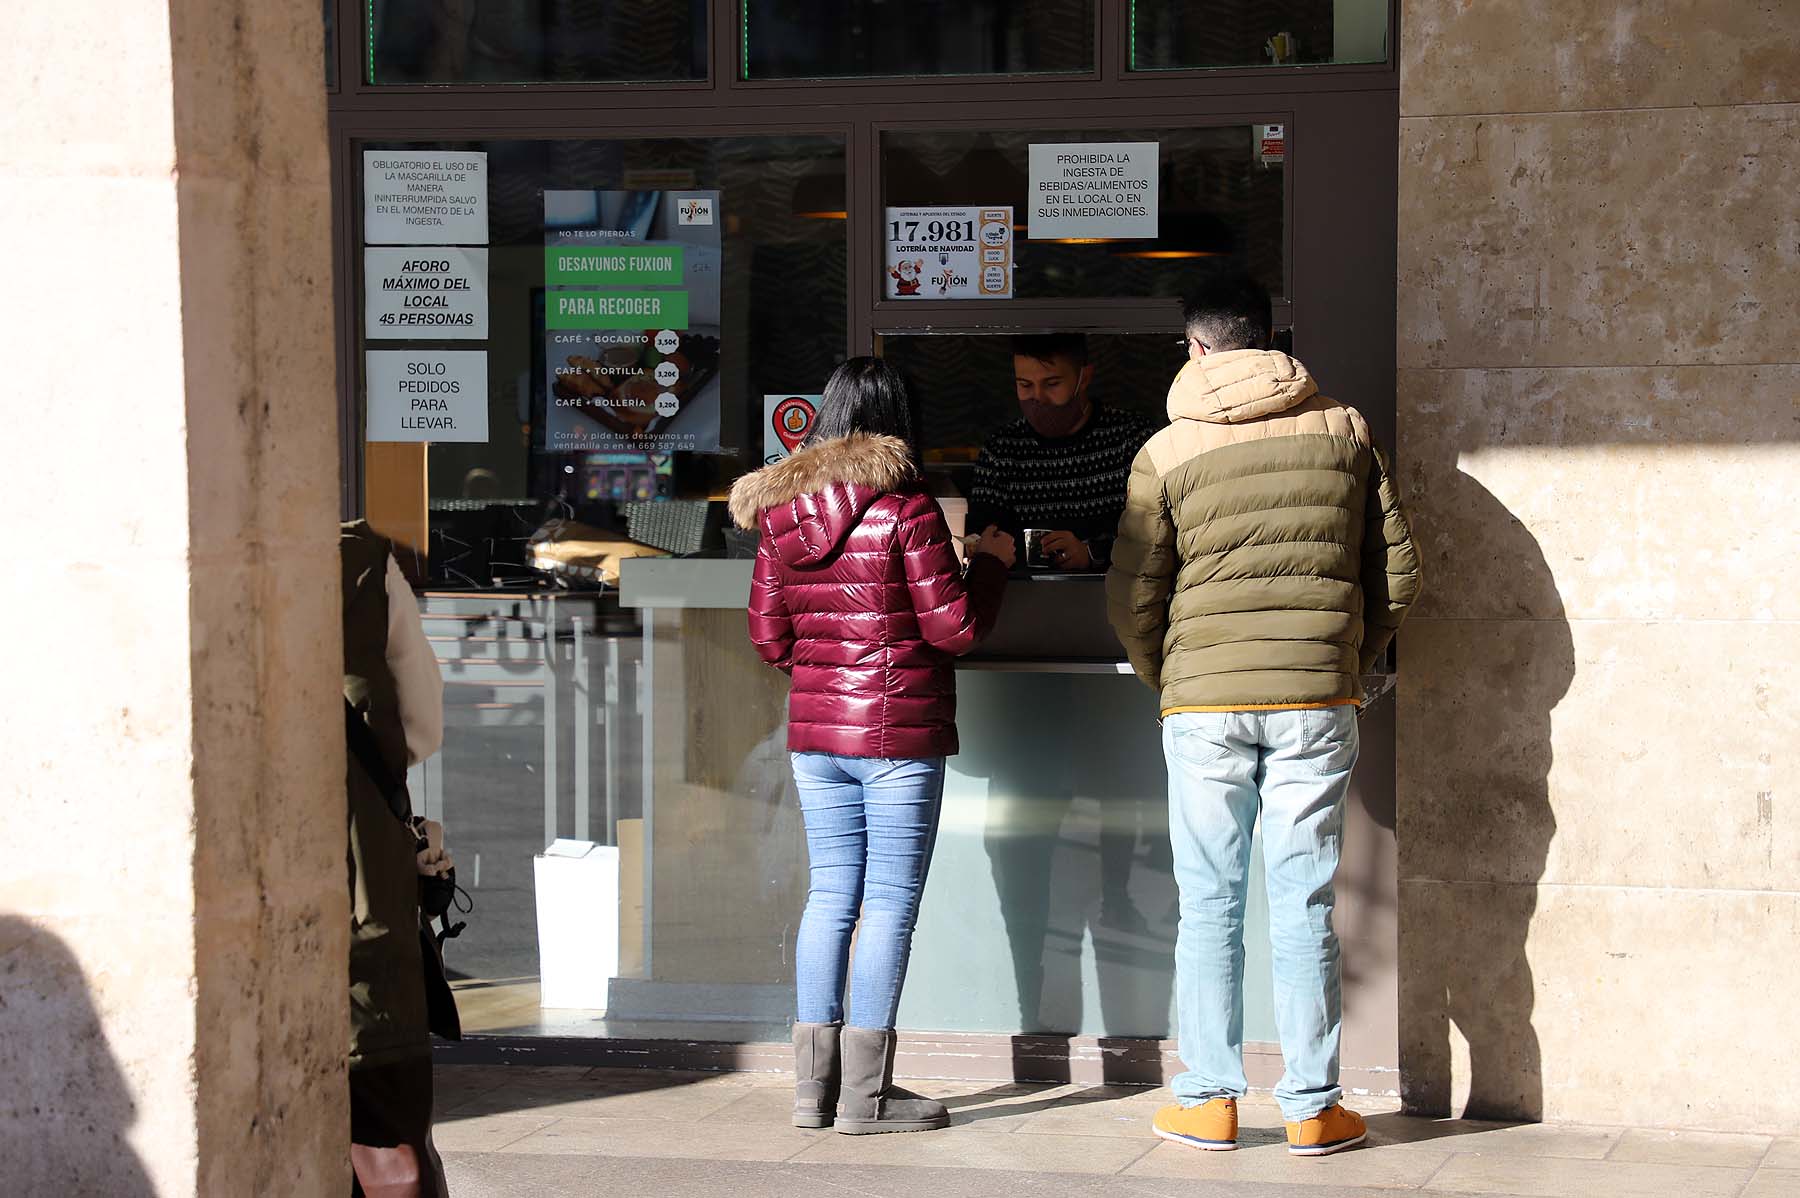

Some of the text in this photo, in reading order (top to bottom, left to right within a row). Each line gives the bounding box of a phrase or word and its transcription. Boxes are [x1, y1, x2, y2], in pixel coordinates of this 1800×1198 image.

[1057, 154, 1130, 164] PROHIBIDA LA
[372, 160, 478, 171] OBLIGATORIO EL USO DE
[398, 172, 452, 181] MASCARILLA
[454, 173, 466, 182] DE
[1063, 168, 1123, 178] INGESTA DE
[1039, 180, 1148, 191] BEBIDAS/ALIMENTOS
[375, 194, 476, 204] ININTERRUMPIDA SALVO
[1046, 194, 1141, 204] EN EL LOCAL O EN
[402, 207, 448, 215] MOMENTO
[450, 207, 462, 215] DE
[1038, 207, 1148, 217] SUS INMEDIACIONES.
[889, 221, 976, 242] 17.981
[402, 261, 450, 272] AFORO
[559, 257, 672, 271] DESAYUNOS FUXION
[383, 276, 470, 289] MÁXIMO DEL
[404, 296, 448, 307] LOCAL
[559, 298, 661, 314] PARA RECOGER
[379, 314, 473, 325] 45 PERSONAS
[555, 334, 582, 343] CAFÉ
[407, 363, 446, 375] SOLO
[556, 366, 582, 375] CAFÉ
[399, 381, 460, 393] PEDIDOS
[411, 400, 448, 410] PARA
[556, 398, 582, 407] CAFÉ
[595, 398, 646, 407] BOLLERÍA
[401, 418, 457, 429] LLEVAR.
[591, 432, 612, 441] pide
[633, 432, 680, 441] desayunos
